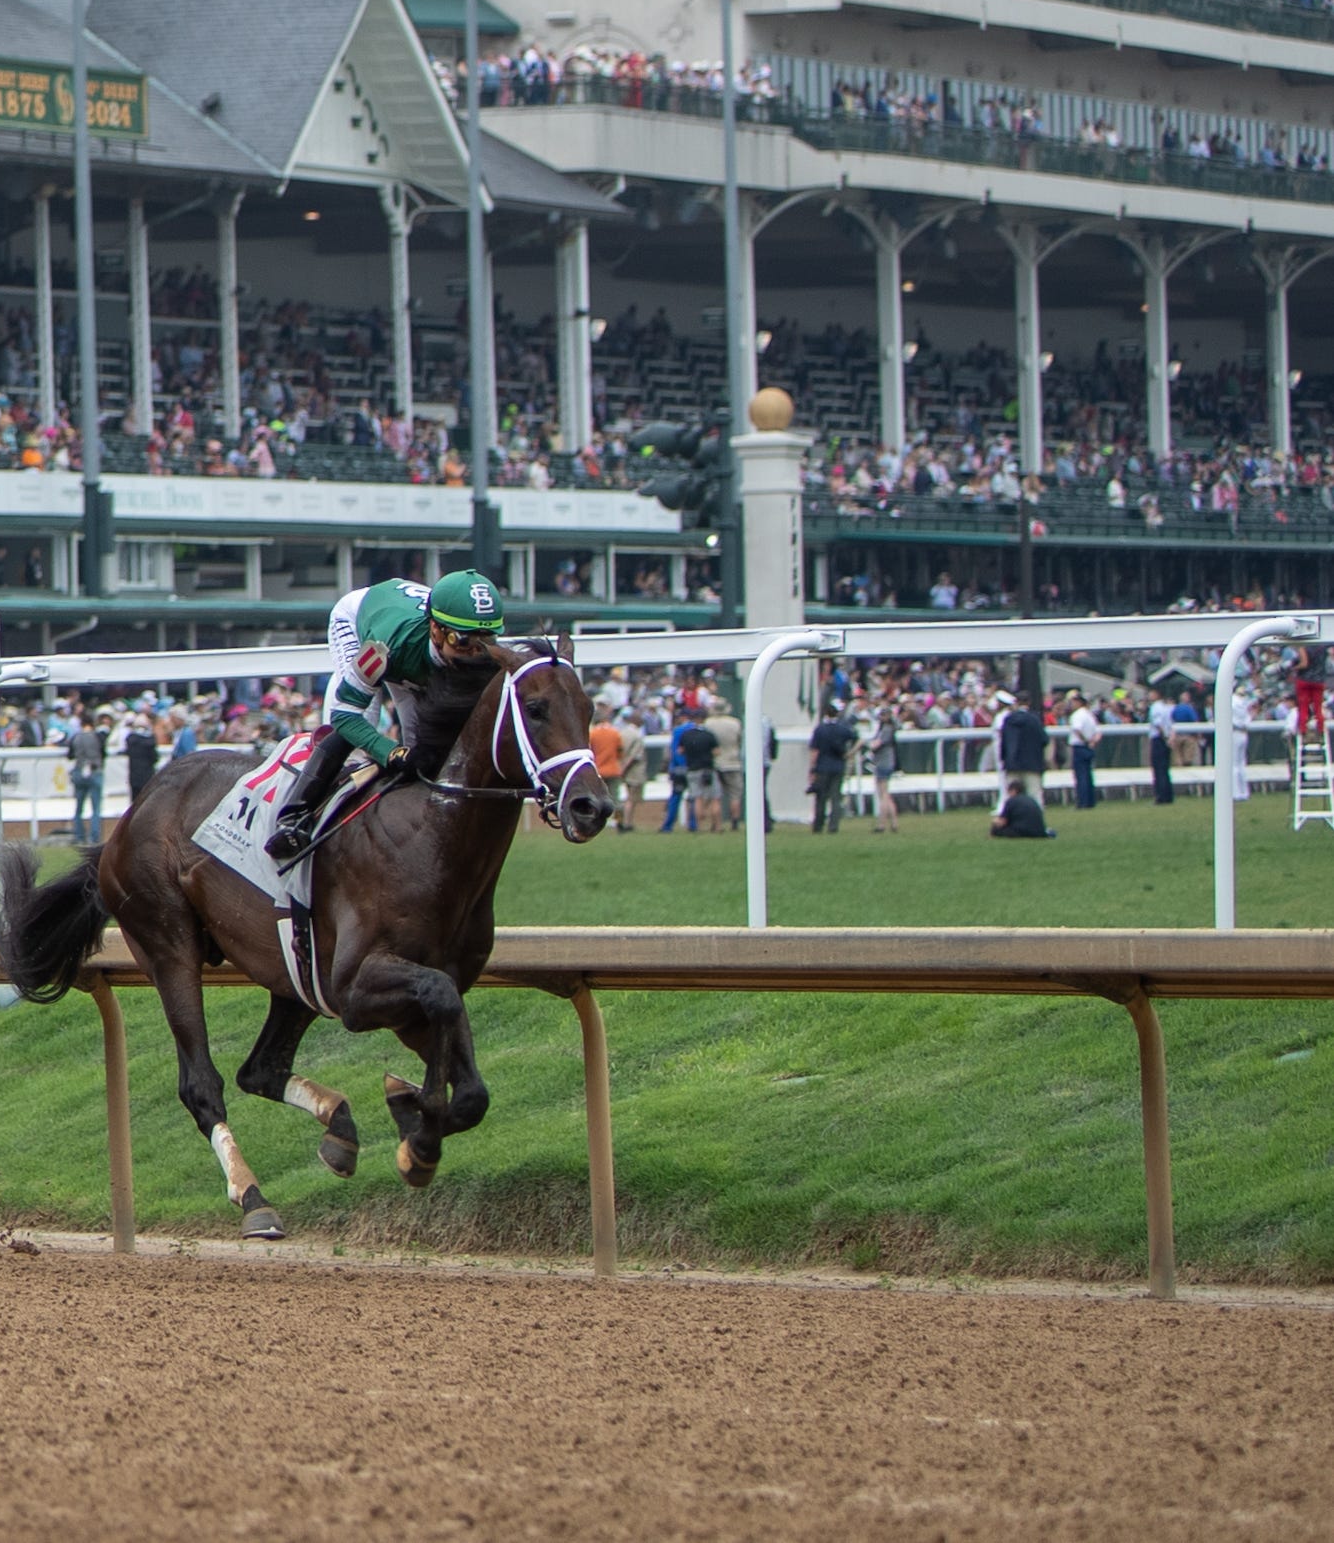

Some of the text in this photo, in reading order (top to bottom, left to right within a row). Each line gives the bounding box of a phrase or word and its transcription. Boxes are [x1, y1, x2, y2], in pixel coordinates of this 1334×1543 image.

[18, 71, 51, 92] DERBY
[102, 81, 138, 103] DERBY
[86, 99, 132, 129] 2024
[357, 646, 383, 679] 11
